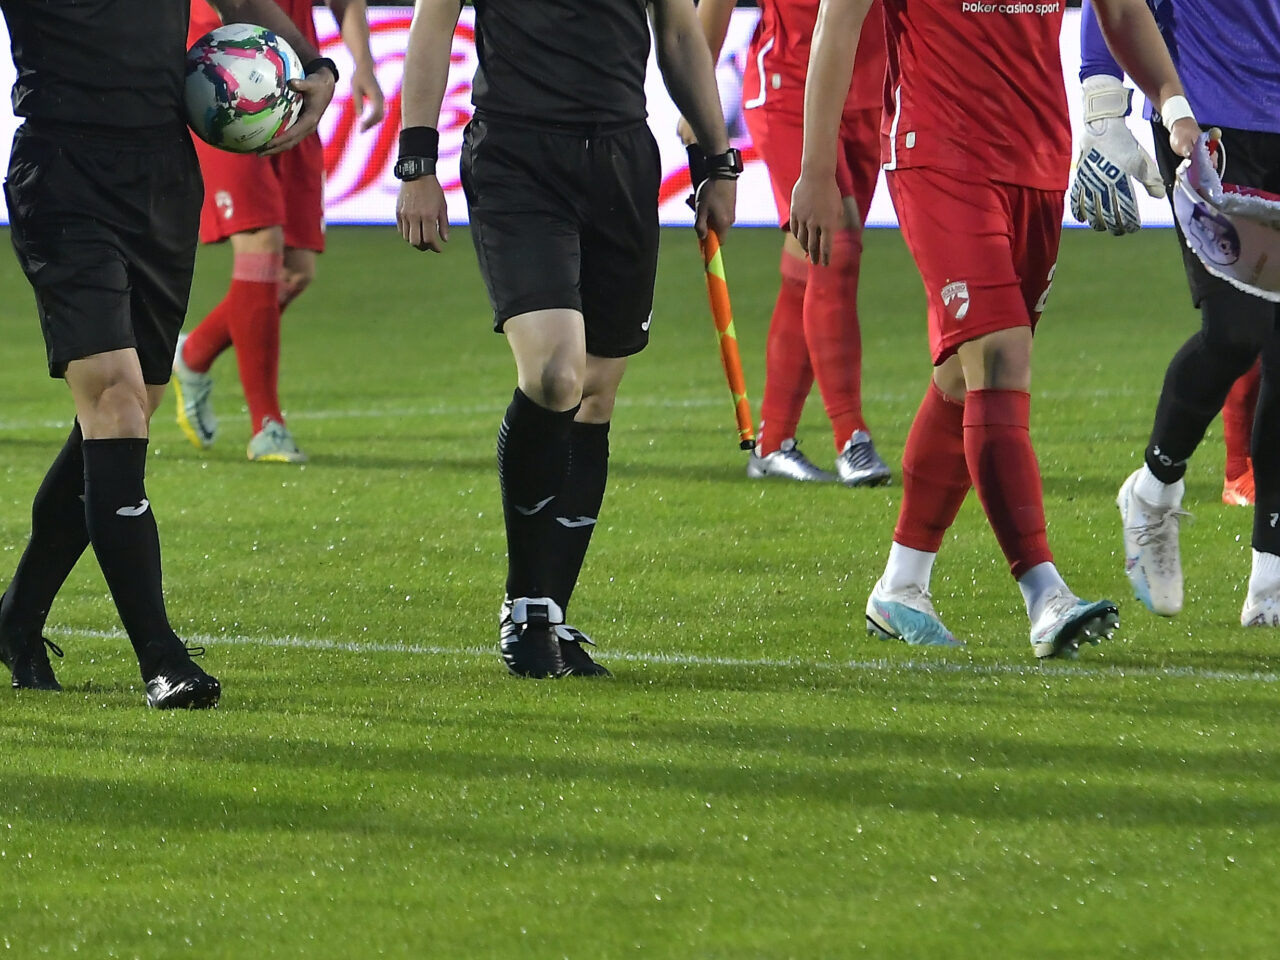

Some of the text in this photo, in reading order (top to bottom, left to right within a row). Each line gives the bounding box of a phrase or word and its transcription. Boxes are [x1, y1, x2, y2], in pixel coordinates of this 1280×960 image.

[962, 1, 1060, 16] poker casino sport
